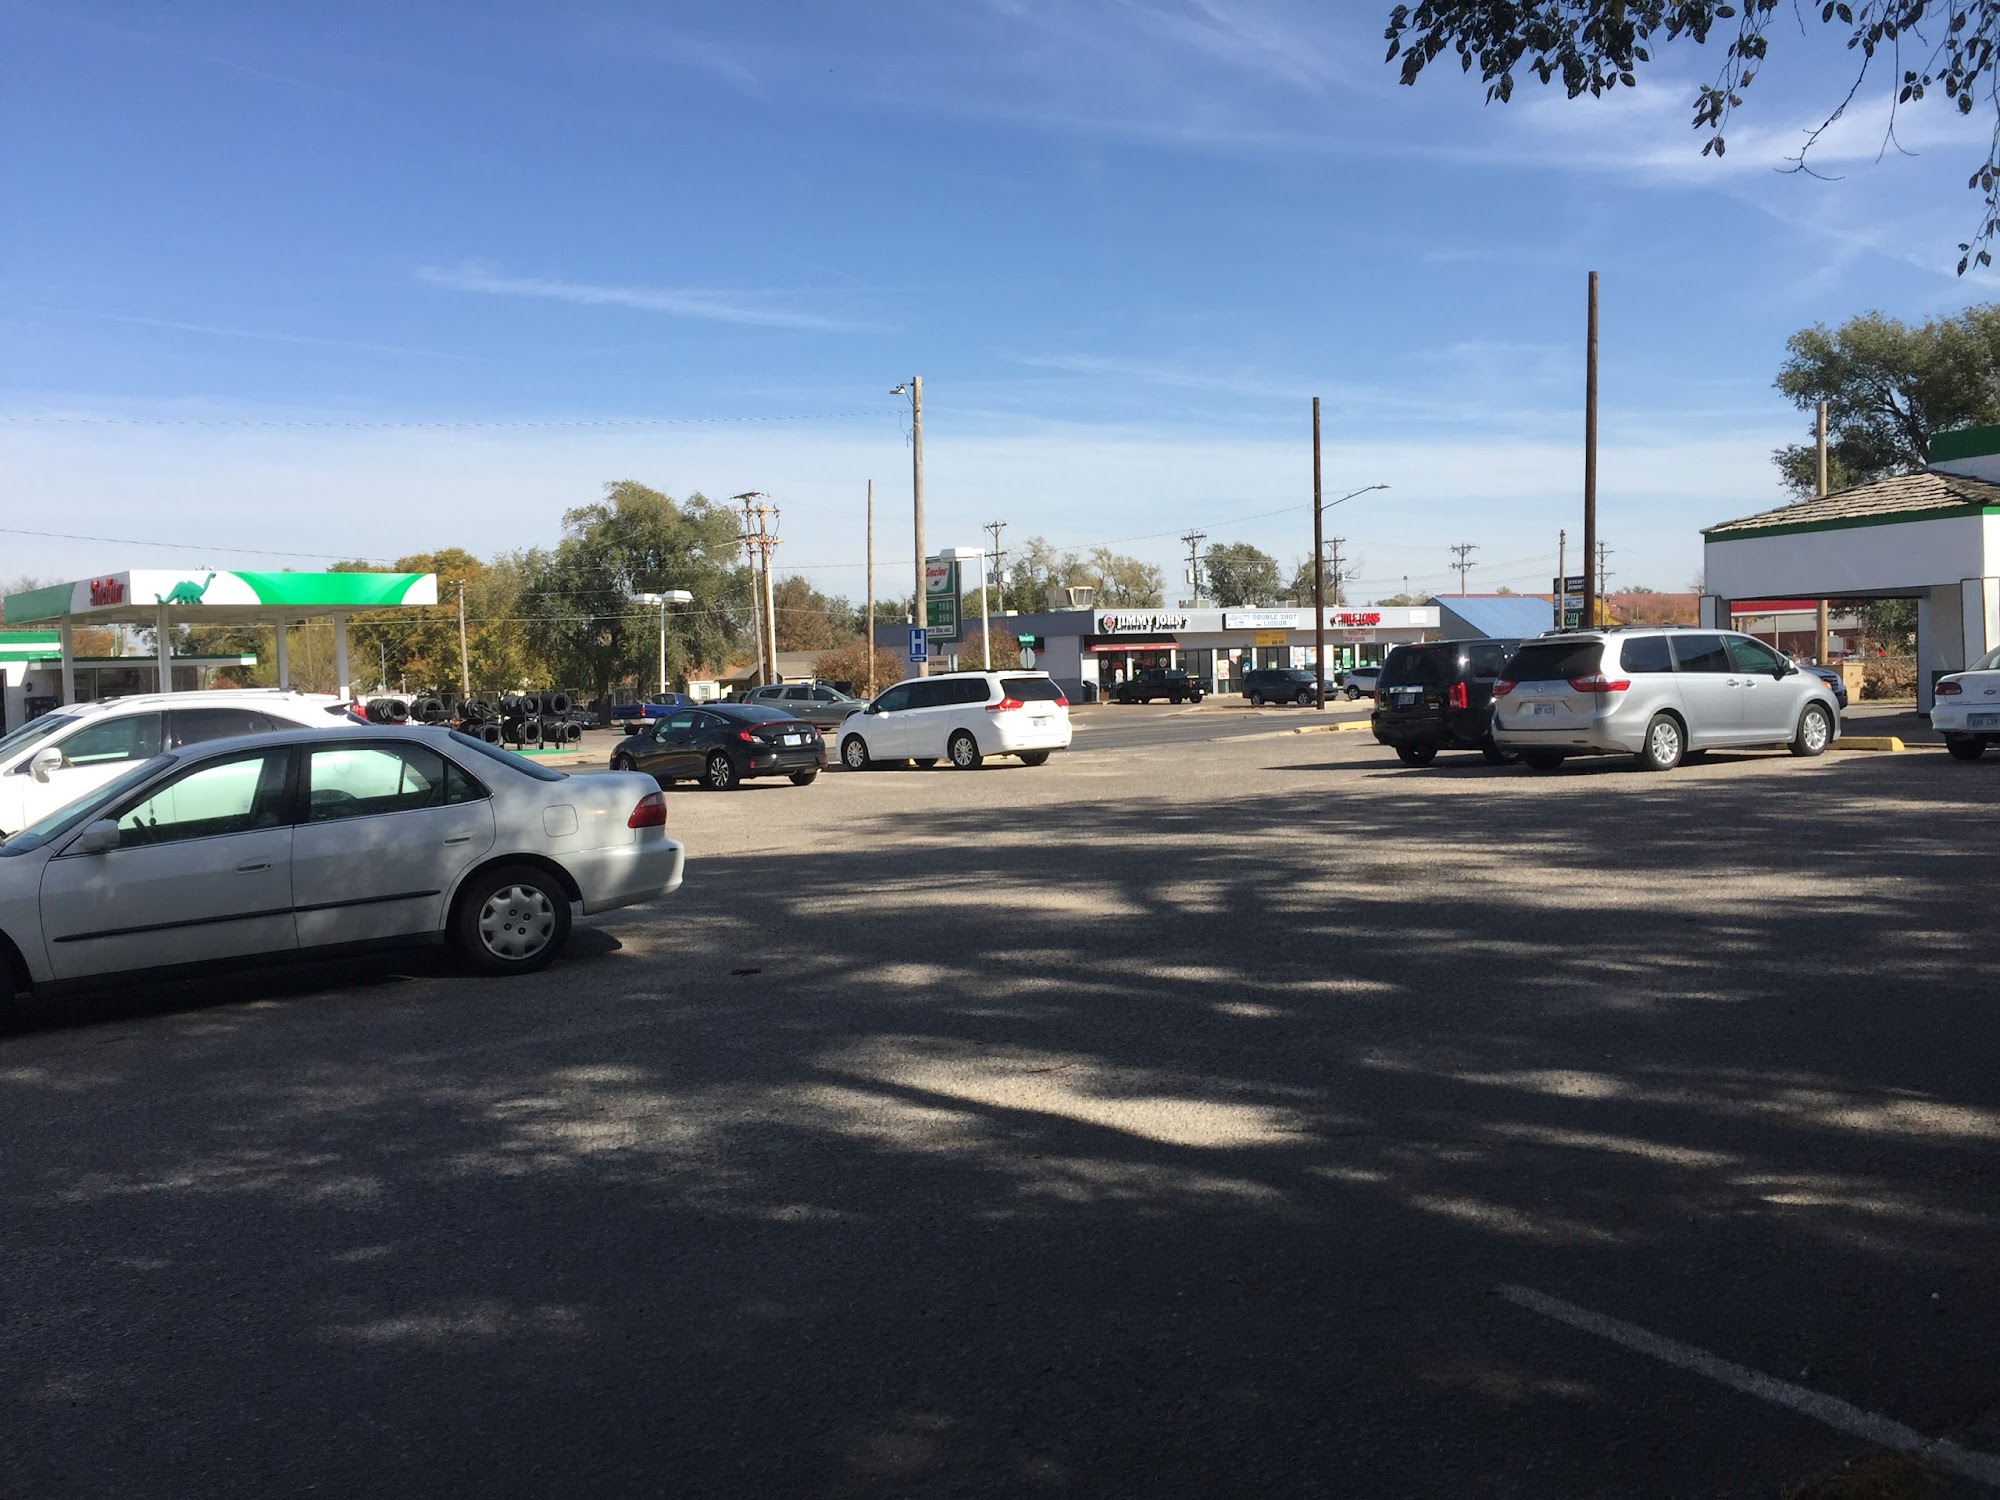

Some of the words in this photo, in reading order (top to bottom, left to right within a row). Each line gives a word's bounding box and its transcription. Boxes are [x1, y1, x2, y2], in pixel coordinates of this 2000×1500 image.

[1117, 615, 1153, 629] JIMMY
[1155, 614, 1191, 629] JOHN'S
[911, 630, 926, 655] H
